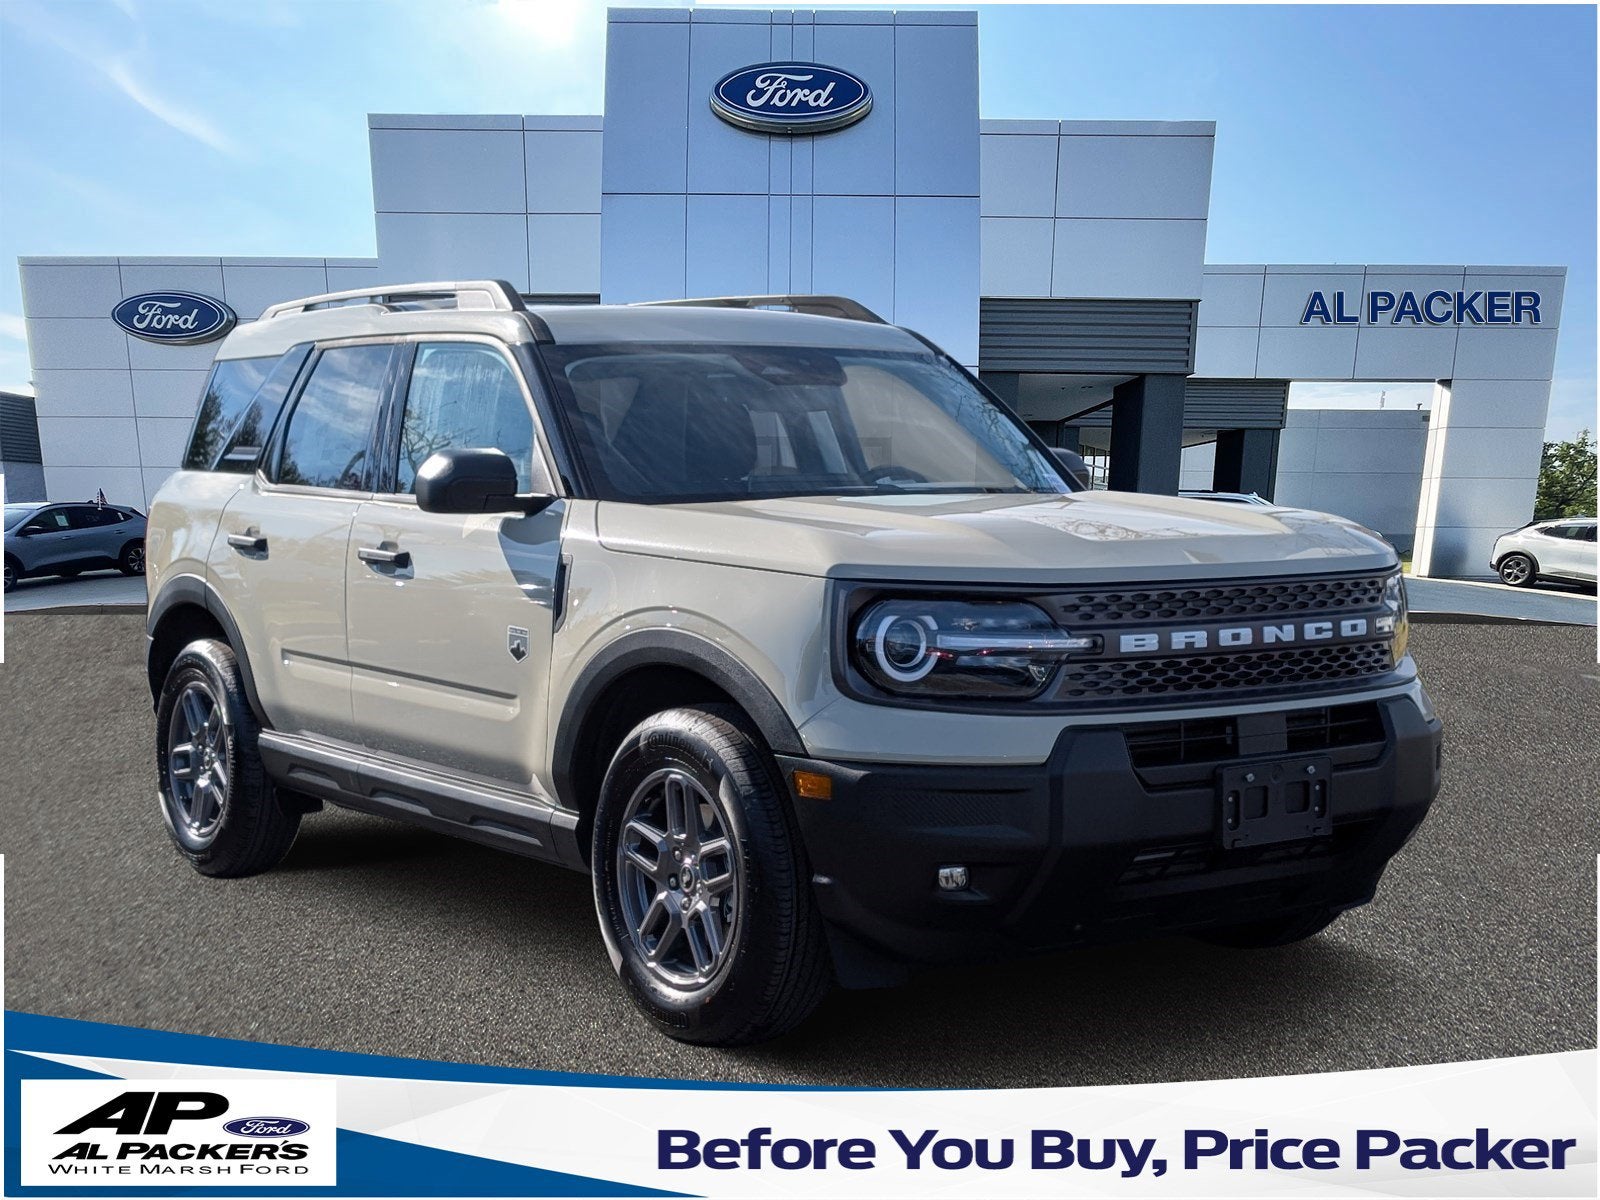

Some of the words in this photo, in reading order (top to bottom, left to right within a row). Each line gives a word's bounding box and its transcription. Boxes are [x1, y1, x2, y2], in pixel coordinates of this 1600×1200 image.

[746, 73, 836, 108] Ford
[133, 301, 199, 329] Ford
[1301, 291, 1360, 324] AL
[1368, 290, 1541, 325] PACKER
[1119, 618, 1368, 652] BRONCO
